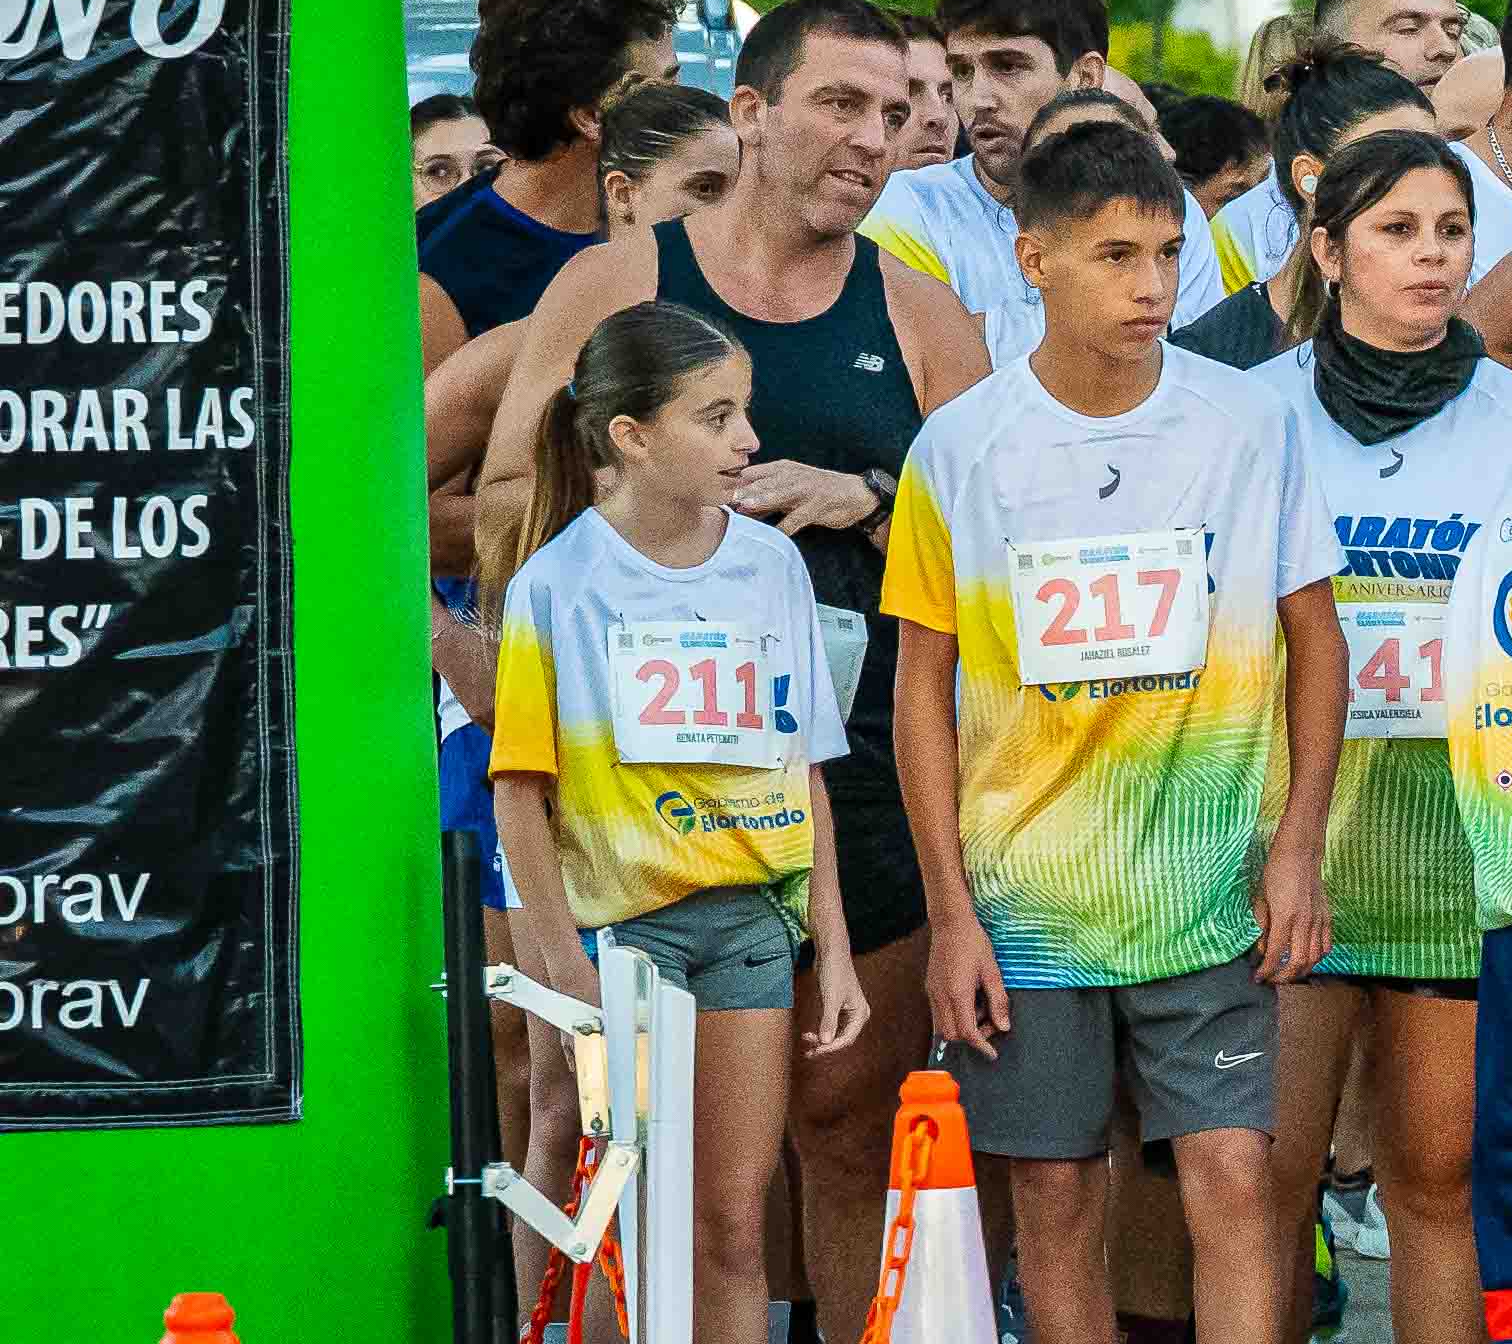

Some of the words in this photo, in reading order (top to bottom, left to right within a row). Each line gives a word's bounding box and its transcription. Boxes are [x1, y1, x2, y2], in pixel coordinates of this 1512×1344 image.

[167, 387, 256, 451] LAS
[20, 497, 96, 560] DE
[112, 494, 211, 560] LOS
[1035, 568, 1182, 647] 217
[636, 659, 763, 730] 211
[1348, 639, 1448, 704] 41
